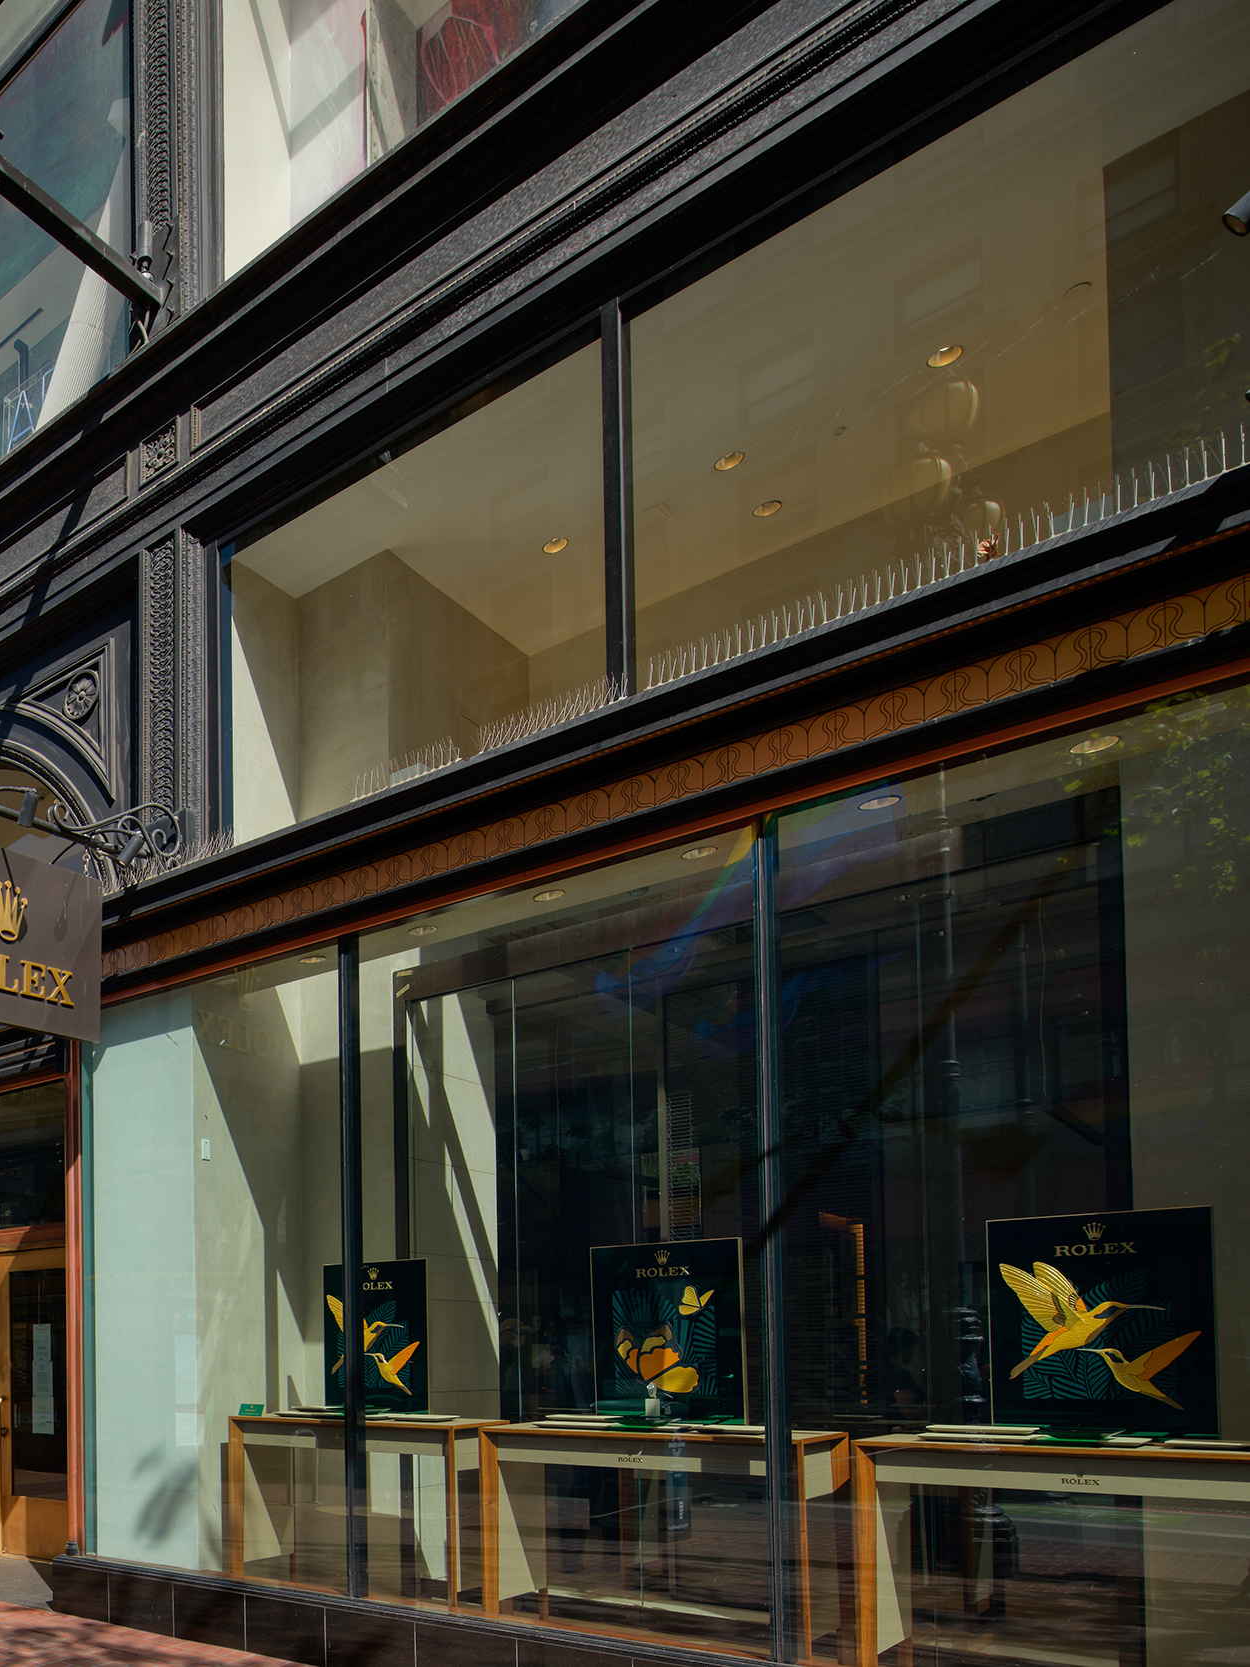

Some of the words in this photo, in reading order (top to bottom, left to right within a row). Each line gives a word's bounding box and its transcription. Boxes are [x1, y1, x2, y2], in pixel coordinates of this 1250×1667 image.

[1053, 1242, 1138, 1257] ROLEX
[635, 1265, 690, 1278] ROLEX
[362, 1281, 393, 1290] OLEX
[1061, 1477, 1100, 1485] ROLEX
